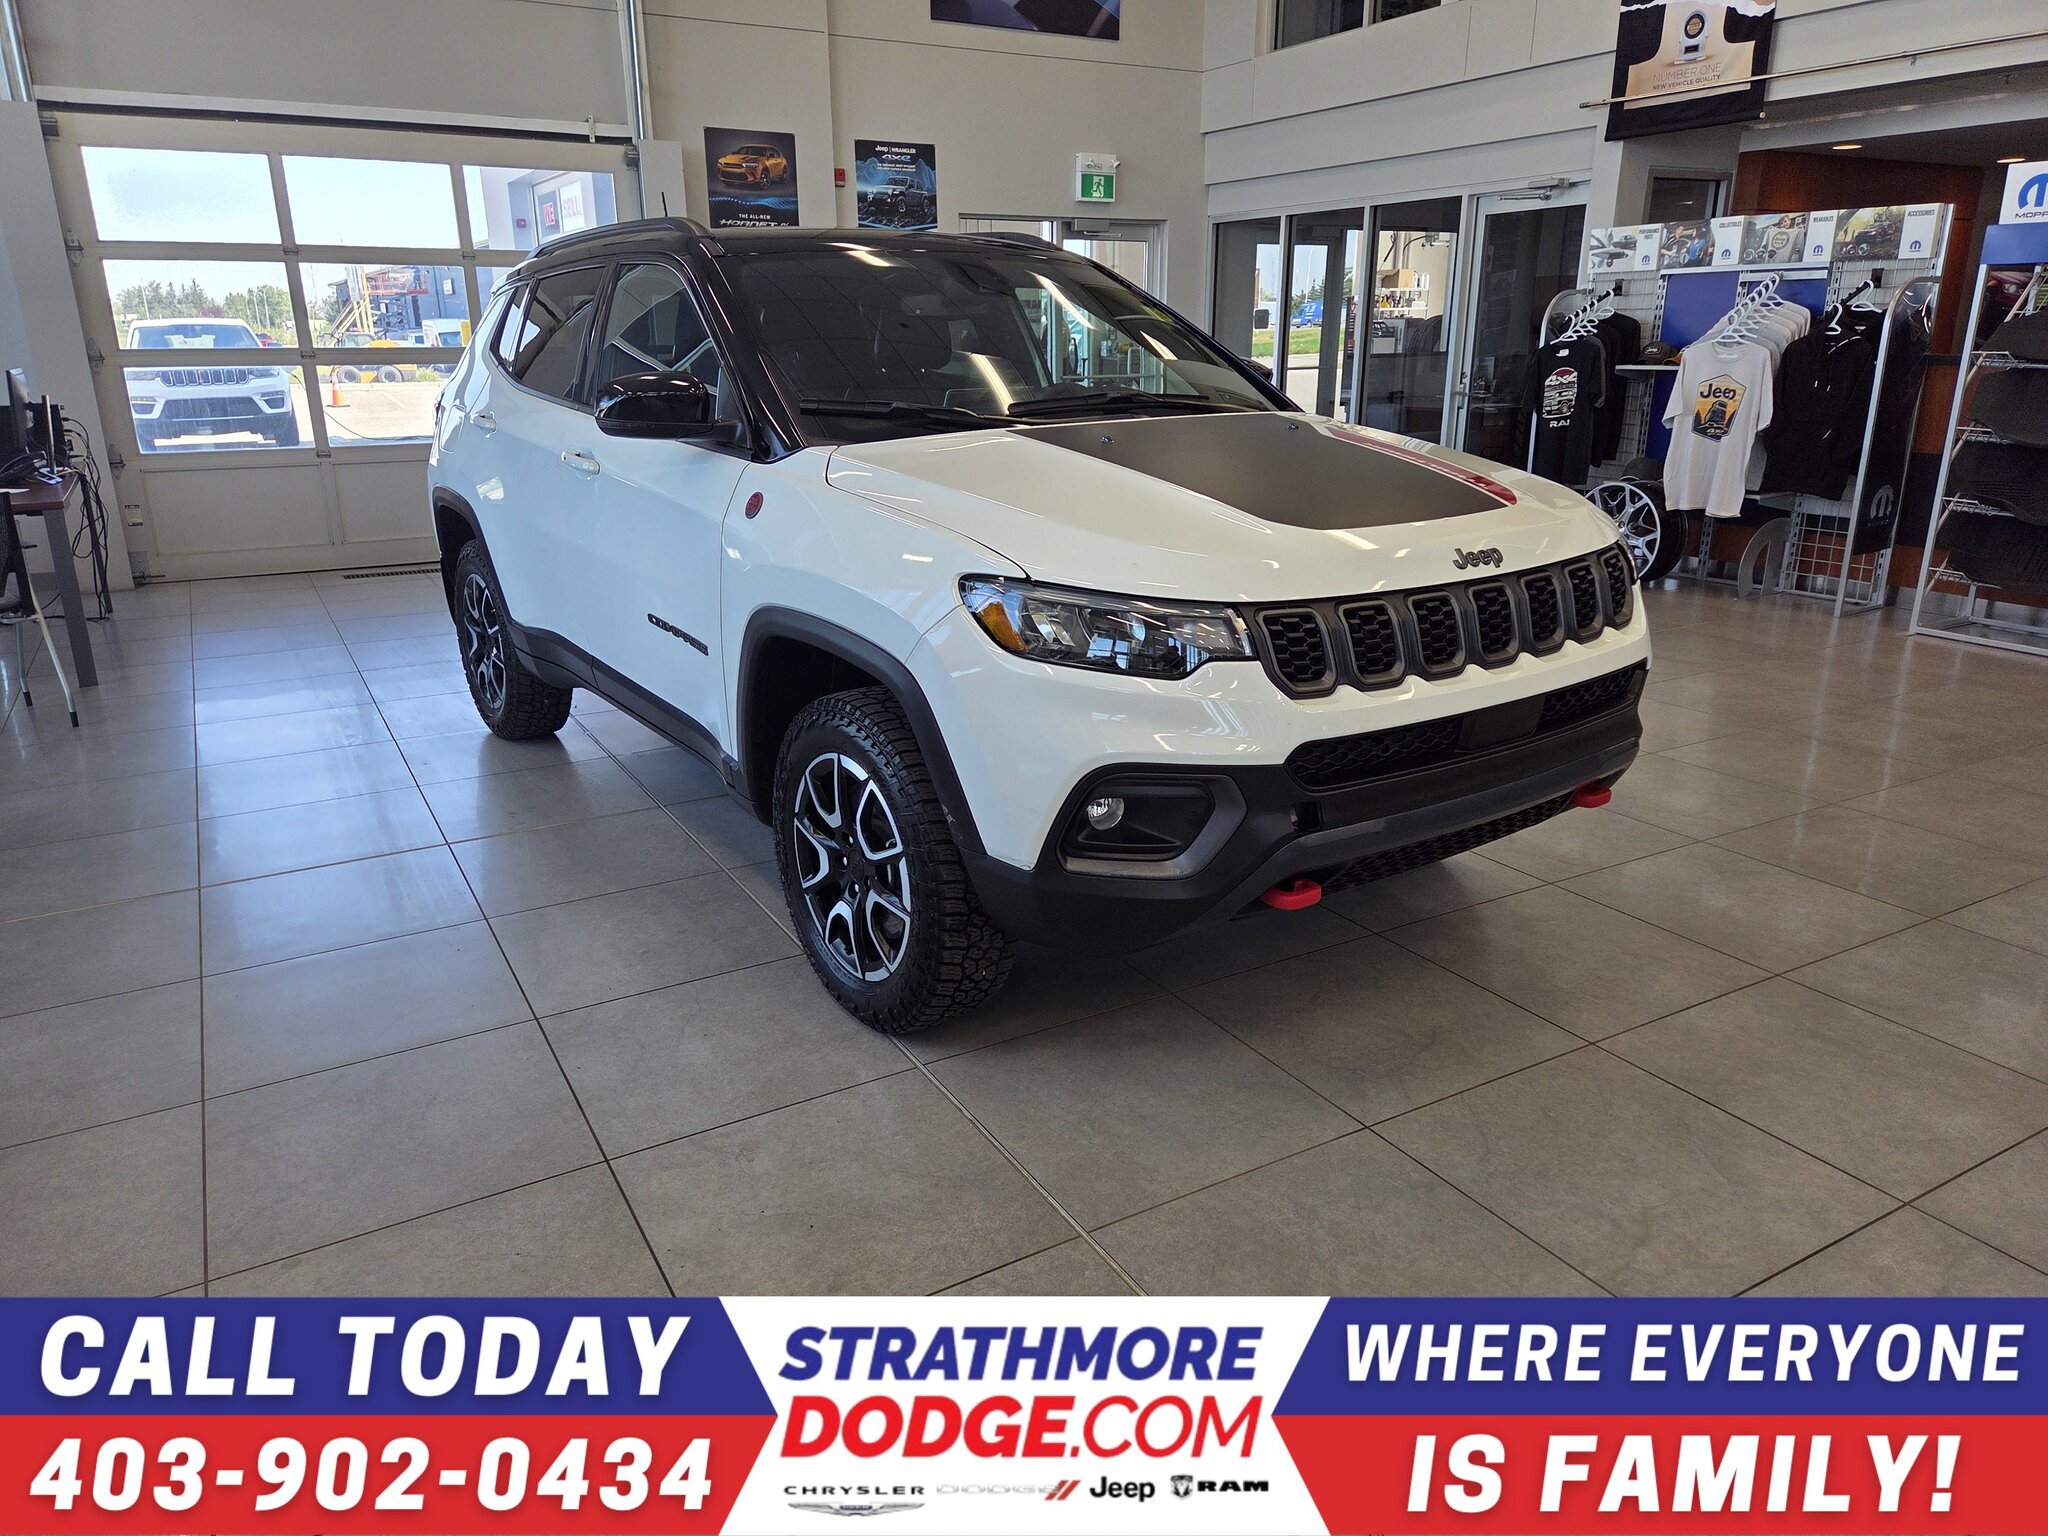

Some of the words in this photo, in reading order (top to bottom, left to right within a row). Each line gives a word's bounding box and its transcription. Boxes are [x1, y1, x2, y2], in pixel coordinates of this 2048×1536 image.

[1652, 67, 1698, 82] NUMBER
[1699, 62, 1722, 76] ONE
[1652, 83, 1667, 91] NEW
[1668, 79, 1693, 88] VEHICLE
[1694, 74, 1722, 84] QUALITY
[874, 145, 889, 153] Jeep
[1452, 547, 1504, 570] Jeep
[647, 612, 709, 657] COMPASS
